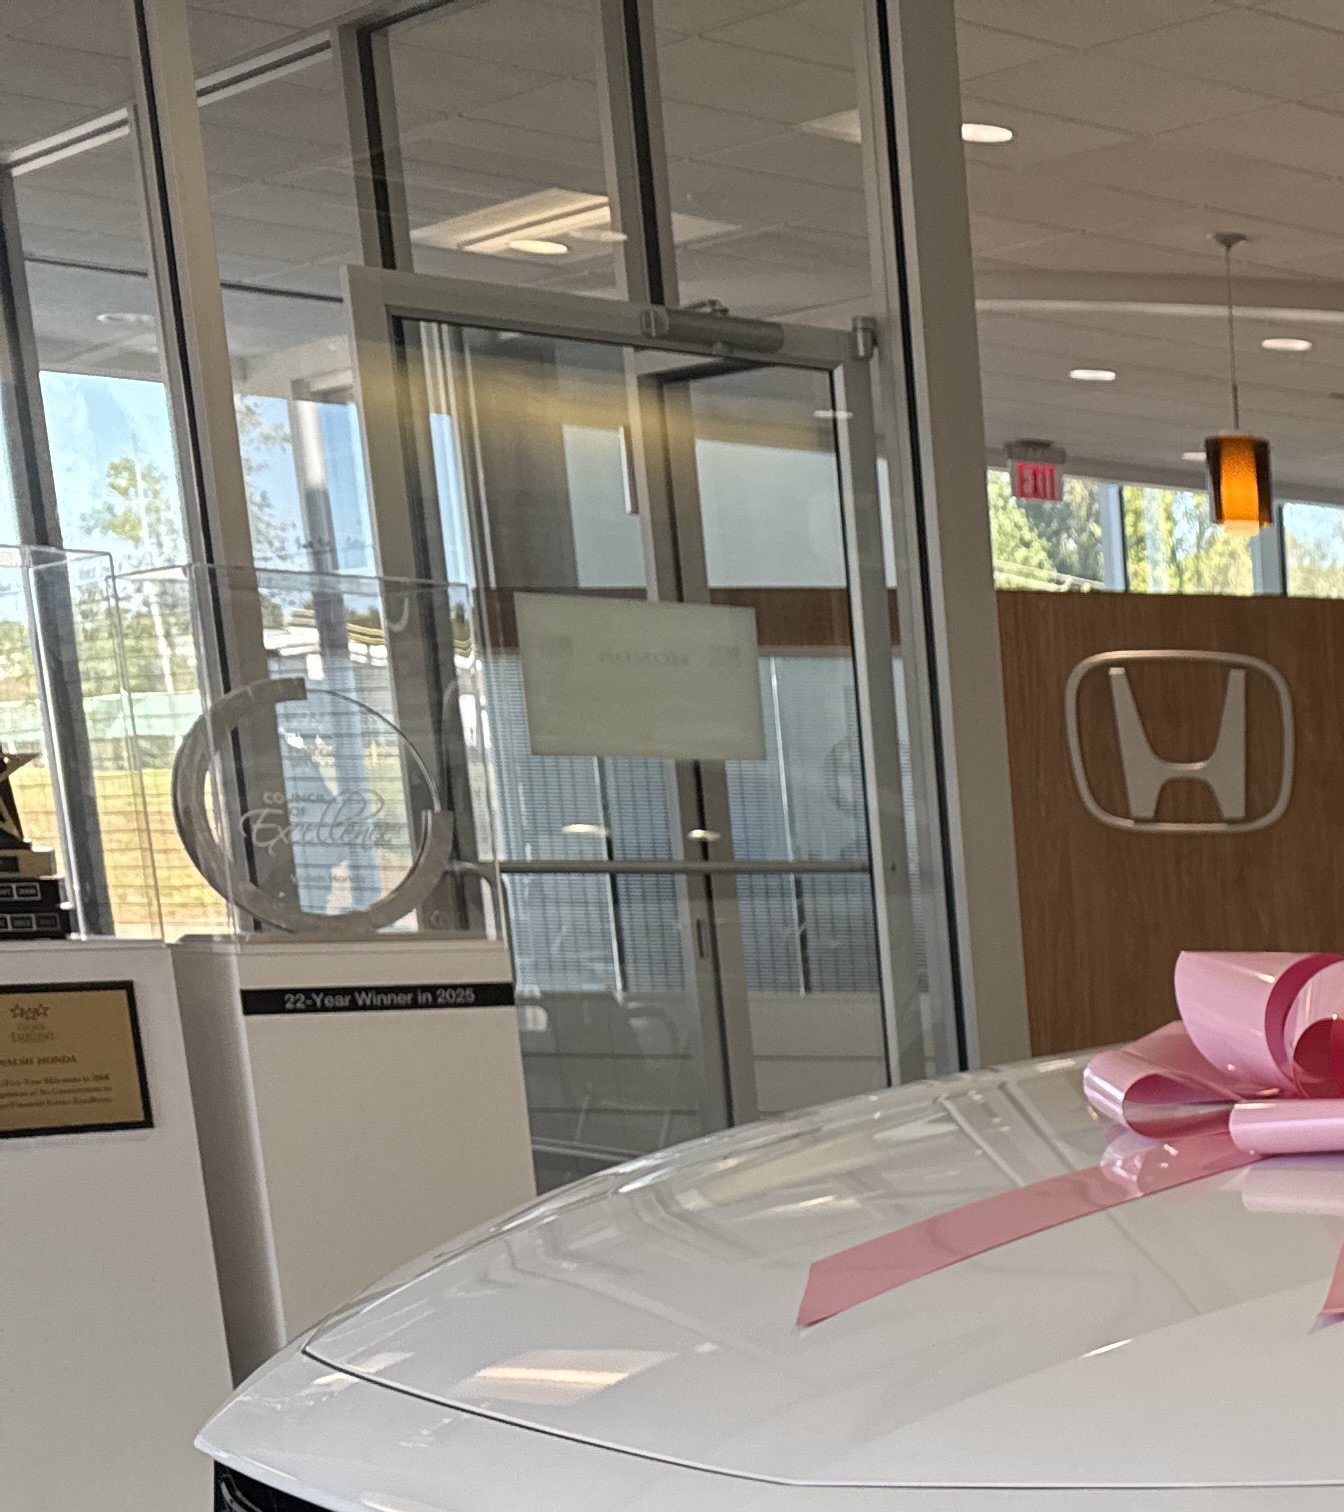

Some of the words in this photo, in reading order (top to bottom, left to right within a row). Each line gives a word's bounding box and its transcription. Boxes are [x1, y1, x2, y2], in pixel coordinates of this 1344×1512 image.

[284, 991, 351, 1009] 22-Year
[353, 990, 414, 1007] Winner
[416, 988, 433, 1005] in
[436, 987, 475, 1004] 2025
